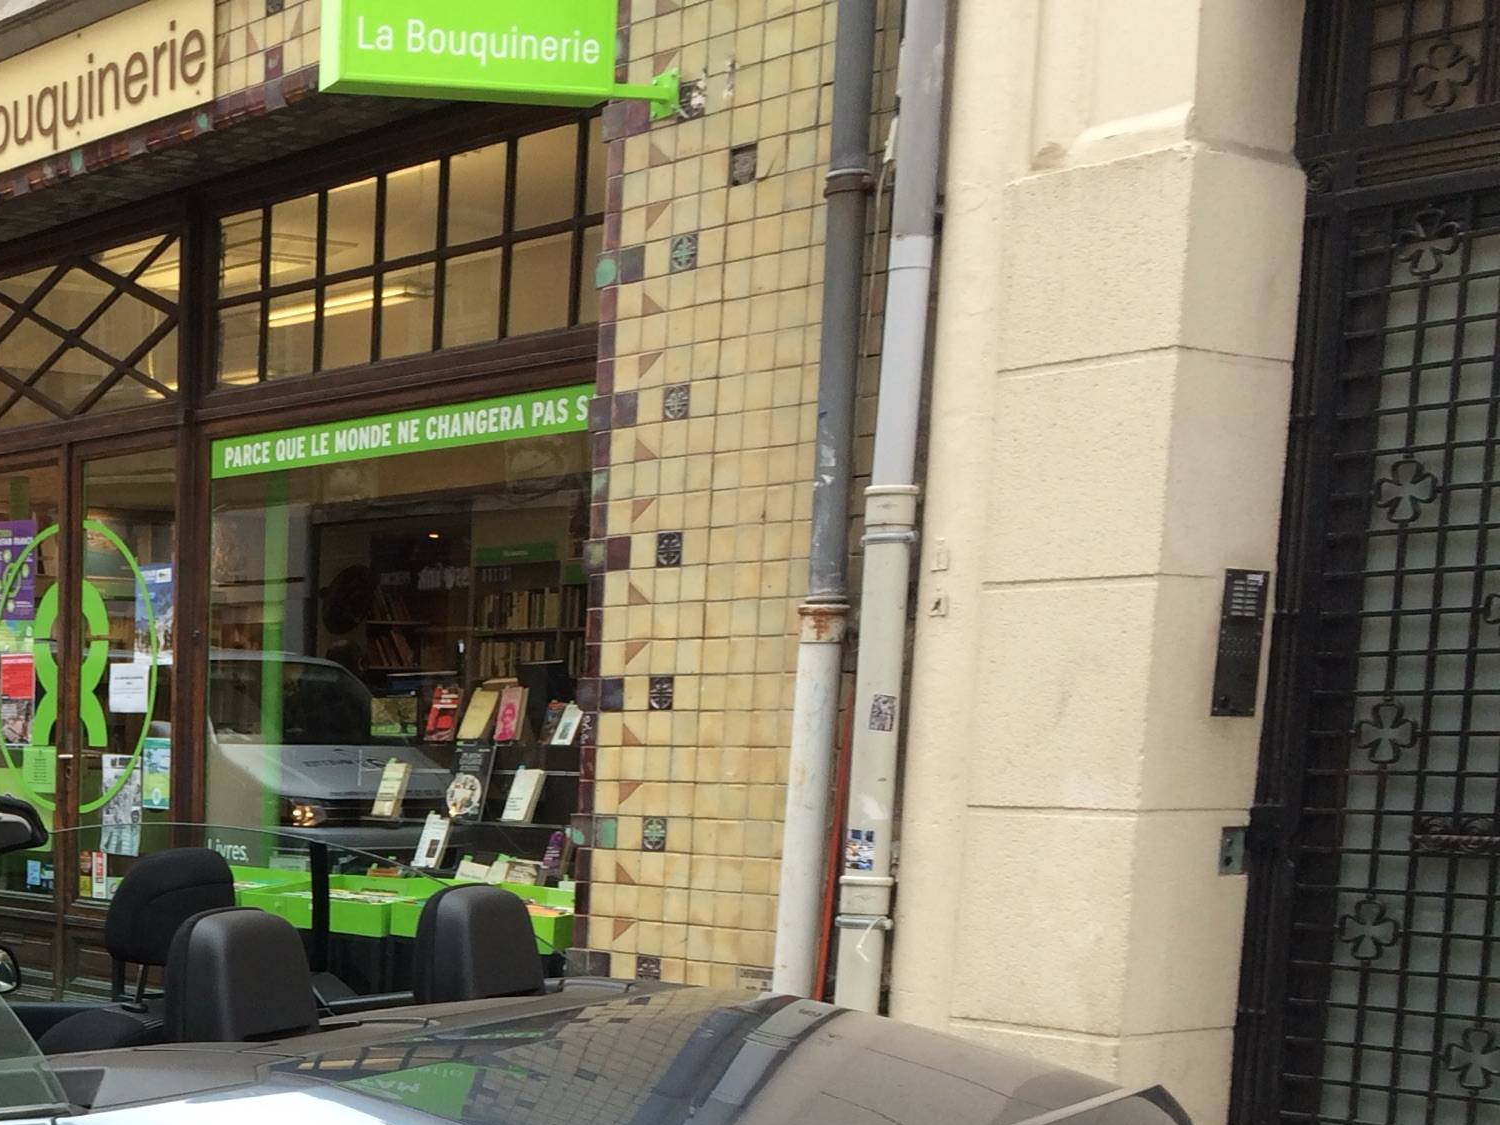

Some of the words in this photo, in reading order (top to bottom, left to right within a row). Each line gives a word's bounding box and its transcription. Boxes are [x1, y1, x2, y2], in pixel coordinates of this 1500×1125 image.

[357, 15, 395, 51] La
[406, 18, 600, 67] Bouquinerie
[223, 440, 271, 470] PARCE
[274, 436, 306, 462] QUE
[310, 432, 330, 458] LE
[334, 422, 392, 453] MONDE
[396, 418, 421, 445] NE
[425, 404, 525, 441] CHANGERA
[531, 397, 569, 427] PAS
